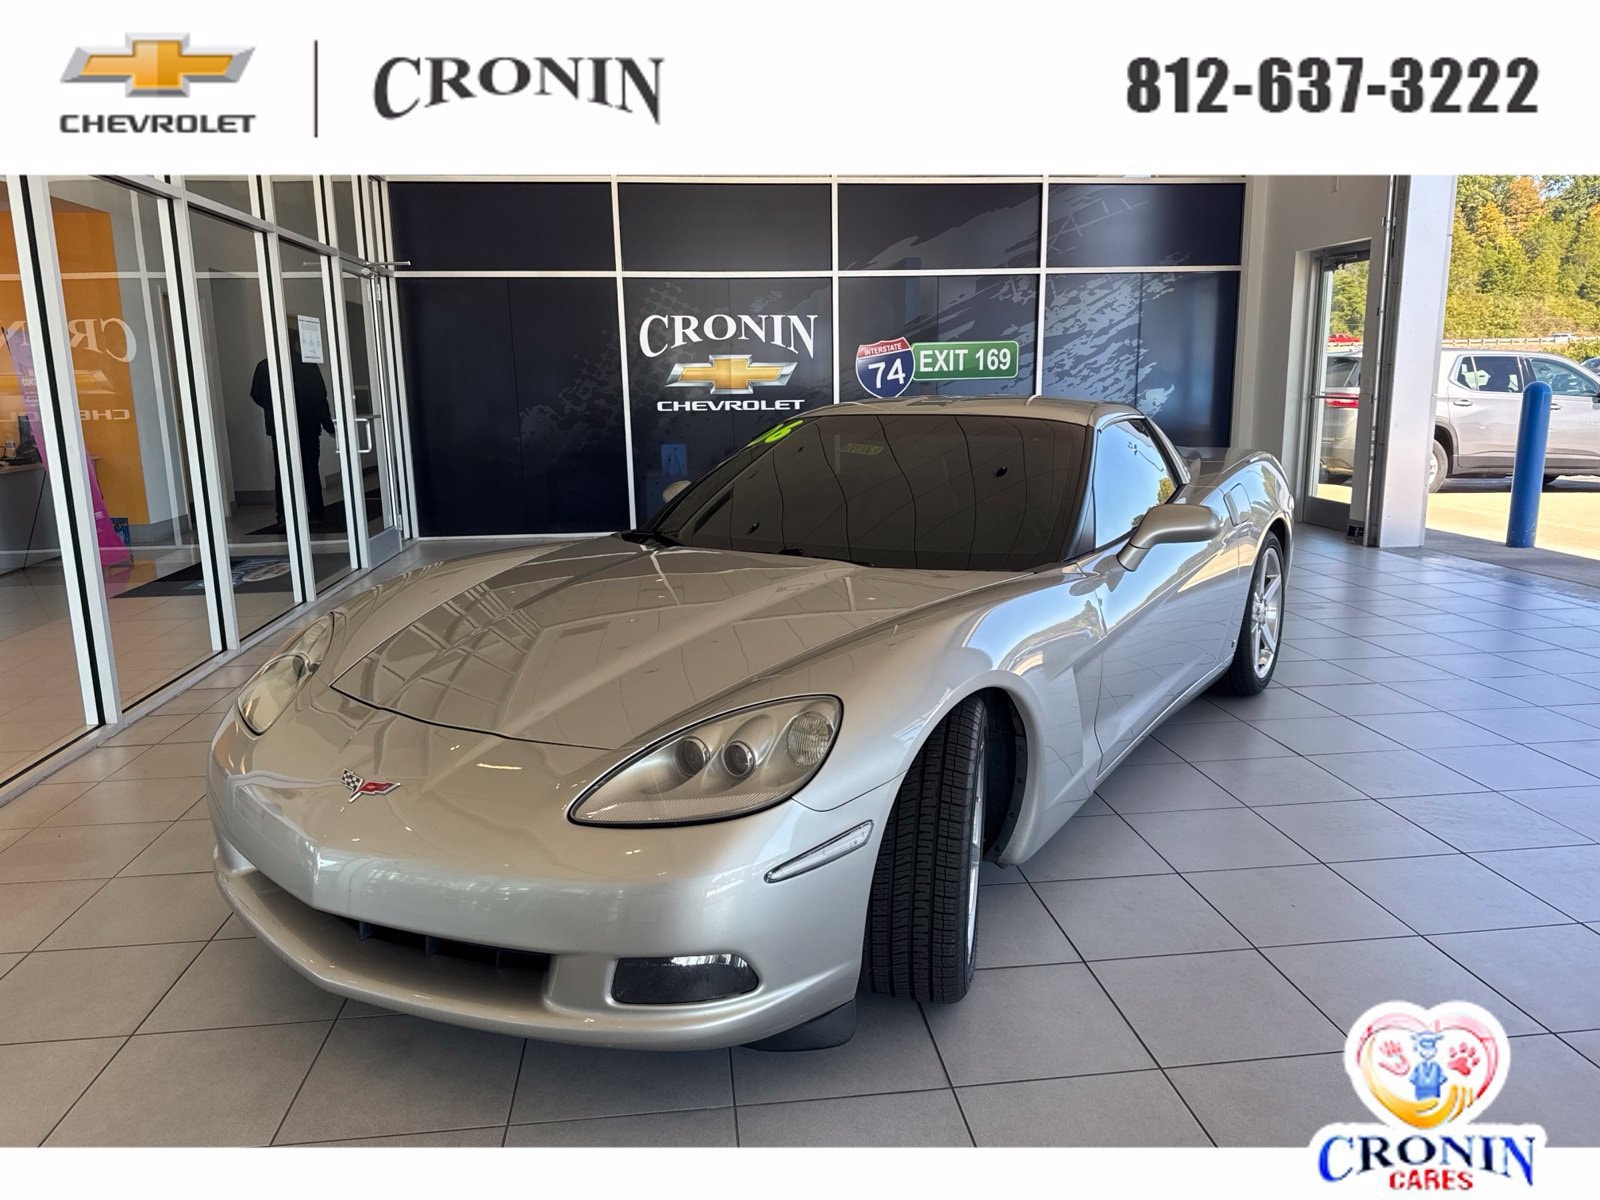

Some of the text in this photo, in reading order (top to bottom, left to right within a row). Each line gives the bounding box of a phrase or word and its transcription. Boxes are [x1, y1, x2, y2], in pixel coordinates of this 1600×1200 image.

[639, 314, 818, 359] CRONIN
[863, 342, 902, 356] INTERSTATE
[919, 348, 1011, 372] EXIT 169
[868, 358, 906, 389] 74
[657, 400, 805, 412] CHEVROLET
